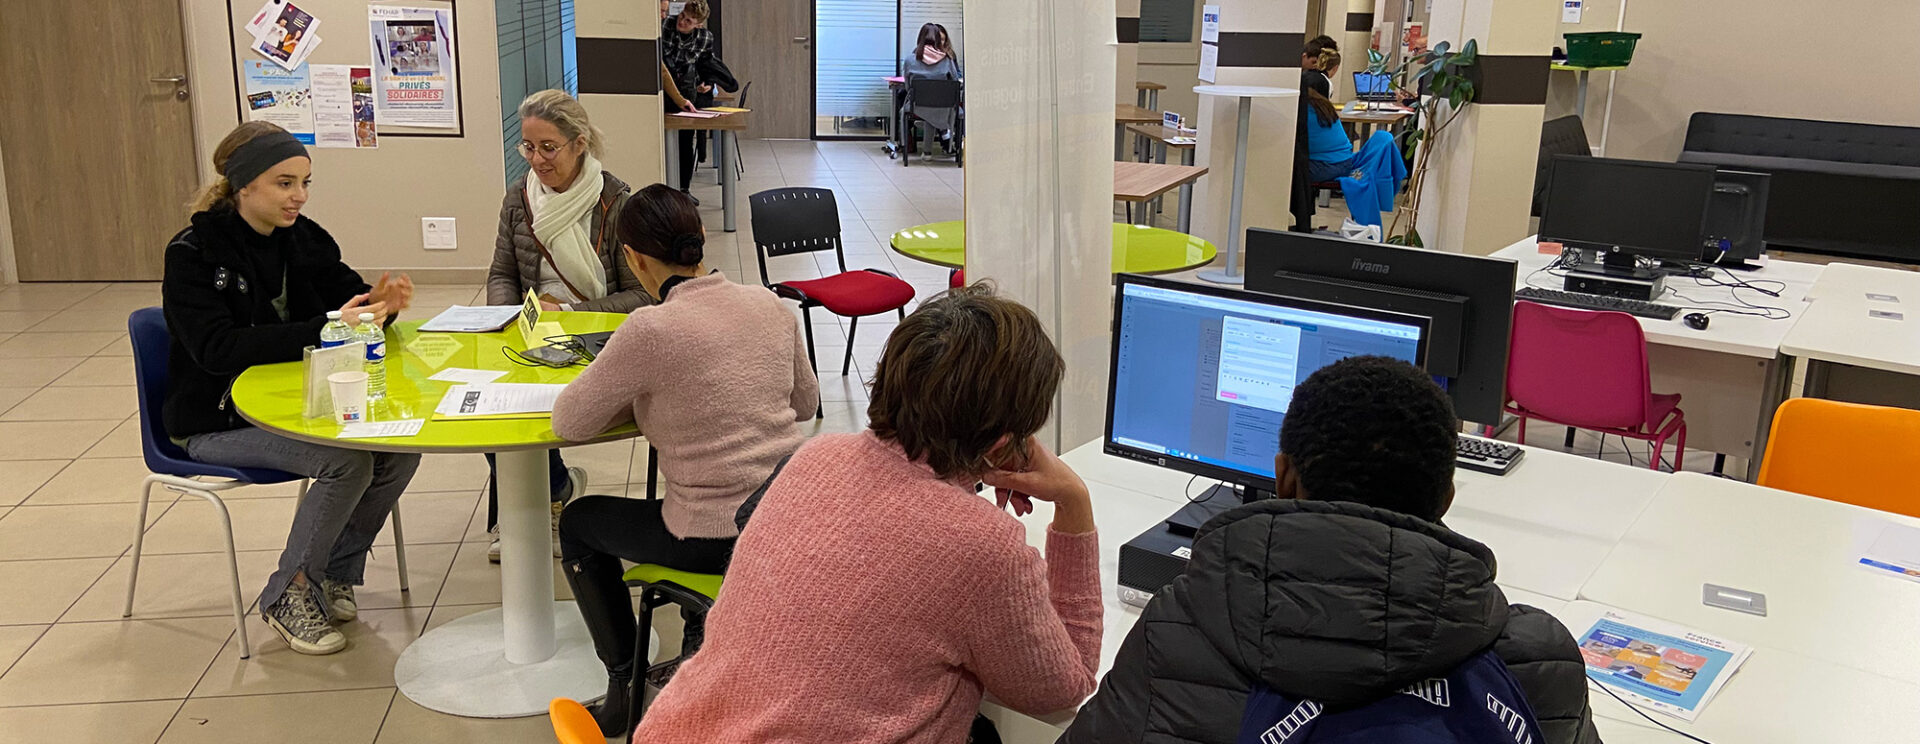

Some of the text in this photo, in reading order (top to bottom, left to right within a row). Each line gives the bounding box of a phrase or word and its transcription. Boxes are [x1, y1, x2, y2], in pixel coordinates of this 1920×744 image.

[399, 81, 431, 89] PRIVÉS
[387, 91, 439, 99] SOLIDAIRES
[1352, 256, 1390, 273] iiyama
